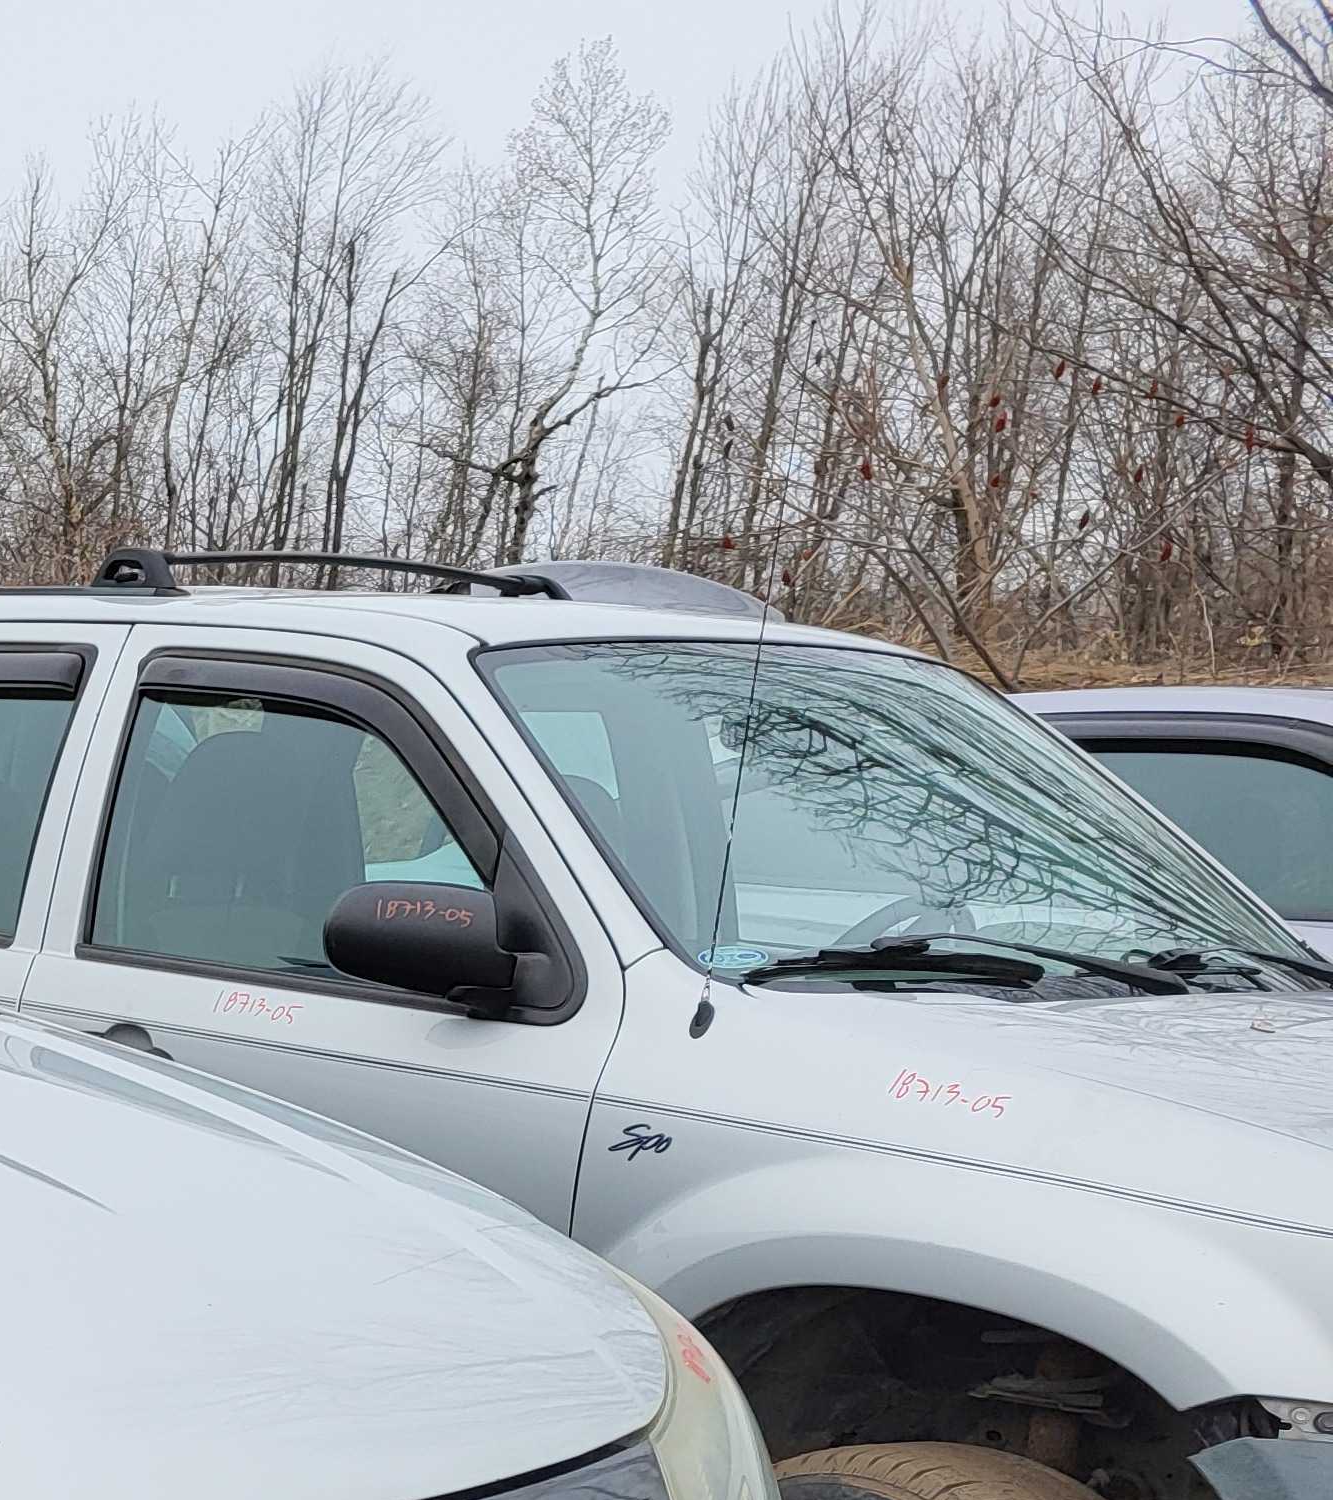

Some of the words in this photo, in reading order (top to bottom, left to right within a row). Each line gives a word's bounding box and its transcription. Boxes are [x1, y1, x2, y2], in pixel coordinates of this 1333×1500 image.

[376, 899, 475, 929] 18713-05
[212, 990, 305, 1025] 18713-05
[888, 1068, 1012, 1119] 18713-05
